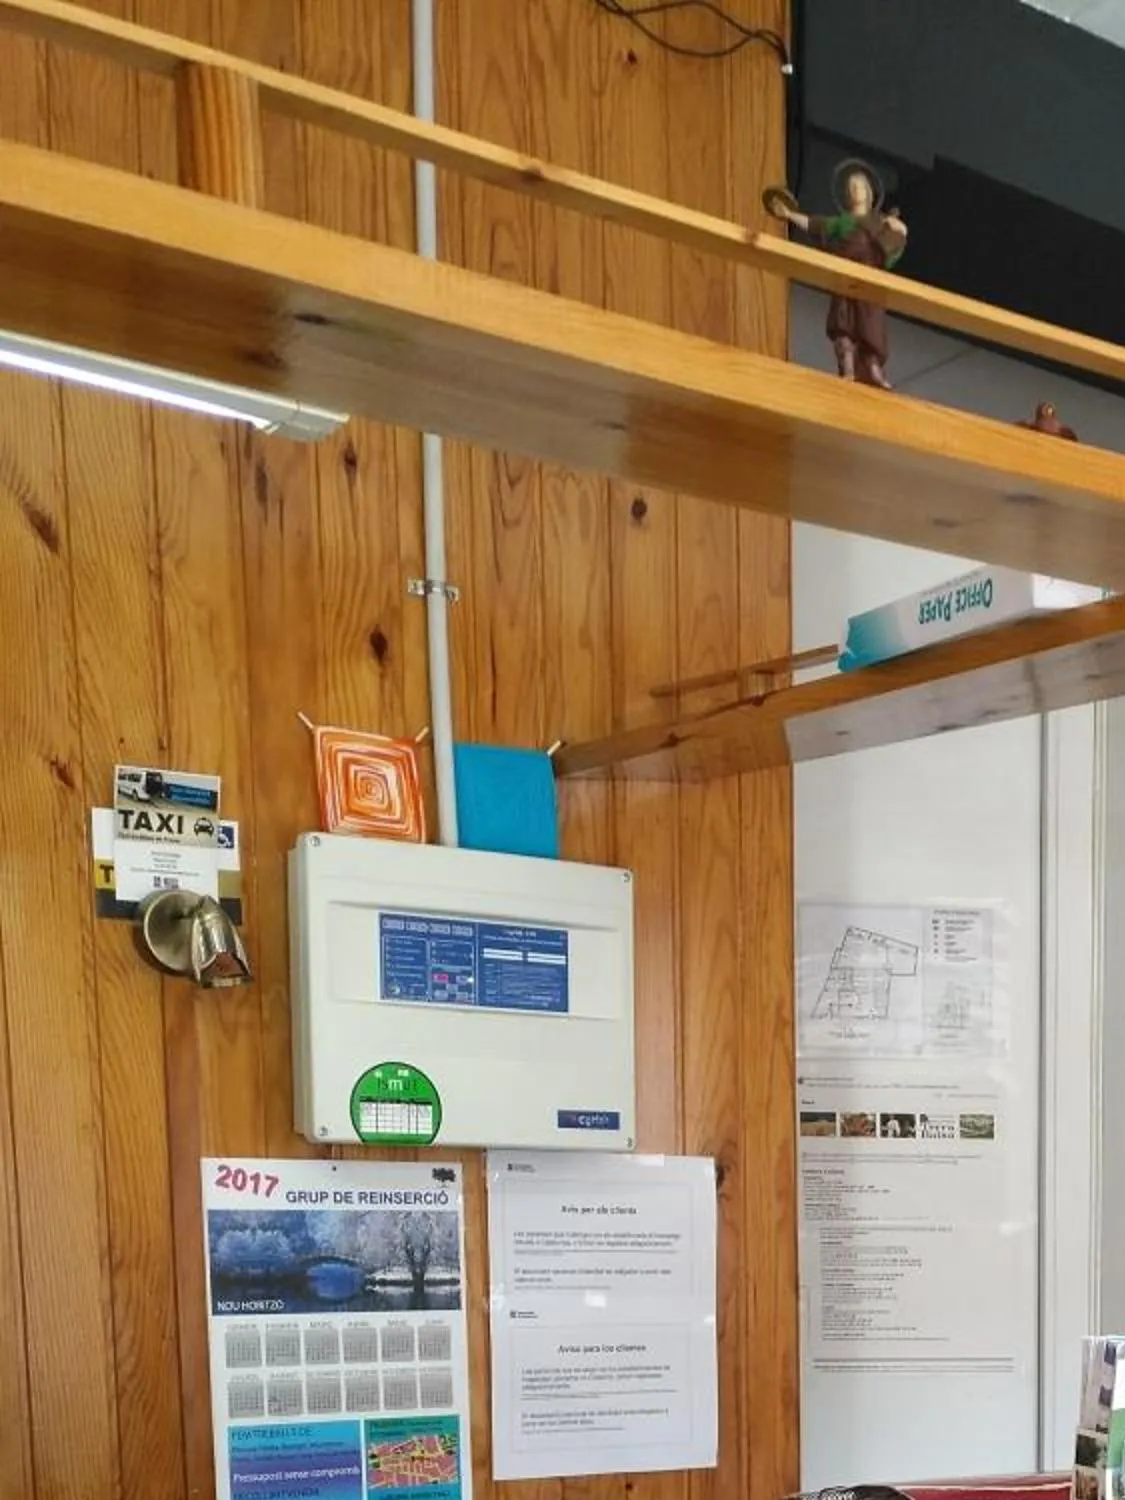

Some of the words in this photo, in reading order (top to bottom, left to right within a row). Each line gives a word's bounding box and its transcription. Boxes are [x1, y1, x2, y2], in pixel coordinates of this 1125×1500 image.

[117, 808, 184, 835] TAXI
[215, 1164, 279, 1198] 2017
[286, 1190, 329, 1204] GRUP
[333, 1191, 354, 1204] DE
[358, 1188, 449, 1205] REINSERCIÓ
